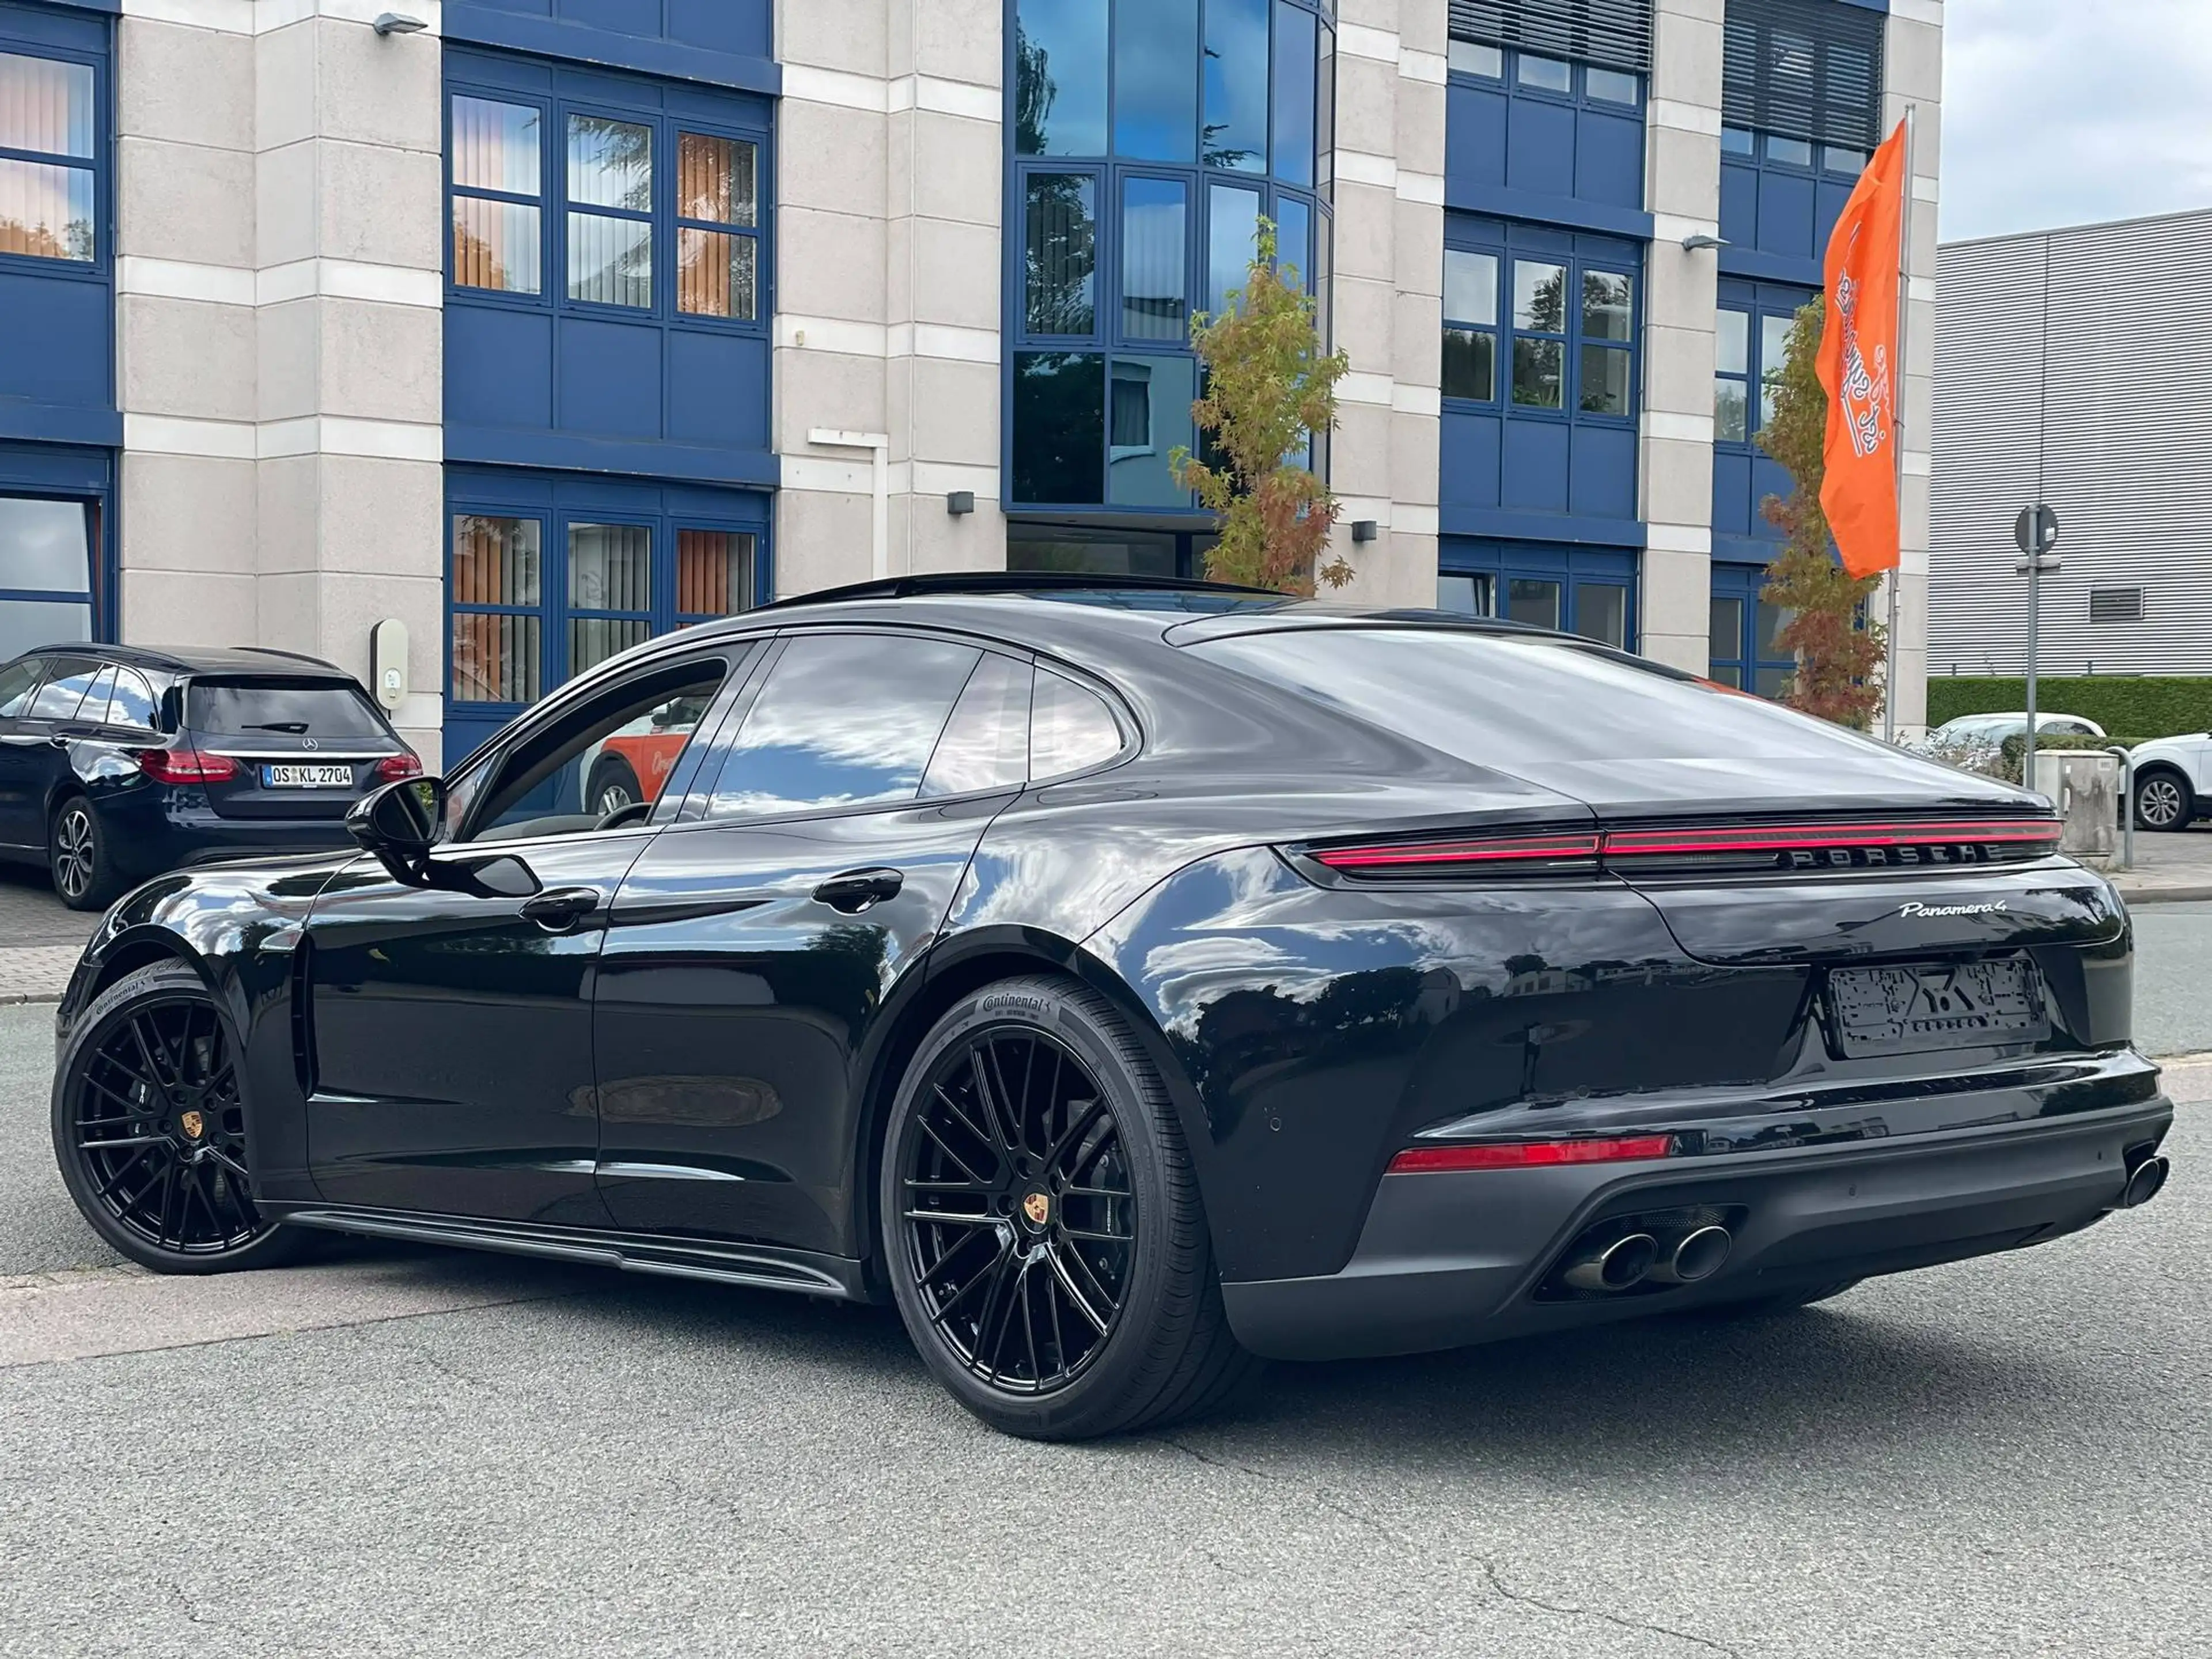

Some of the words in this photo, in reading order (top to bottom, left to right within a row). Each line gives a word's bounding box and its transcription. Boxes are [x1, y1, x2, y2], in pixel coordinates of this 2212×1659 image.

[273, 768, 289, 782] OS
[299, 768, 316, 782] KL
[319, 768, 350, 782] 2704
[1789, 844, 1999, 869] PORSCHE
[1899, 901, 1994, 918] Panamera
[983, 993, 1043, 1012] Continental
